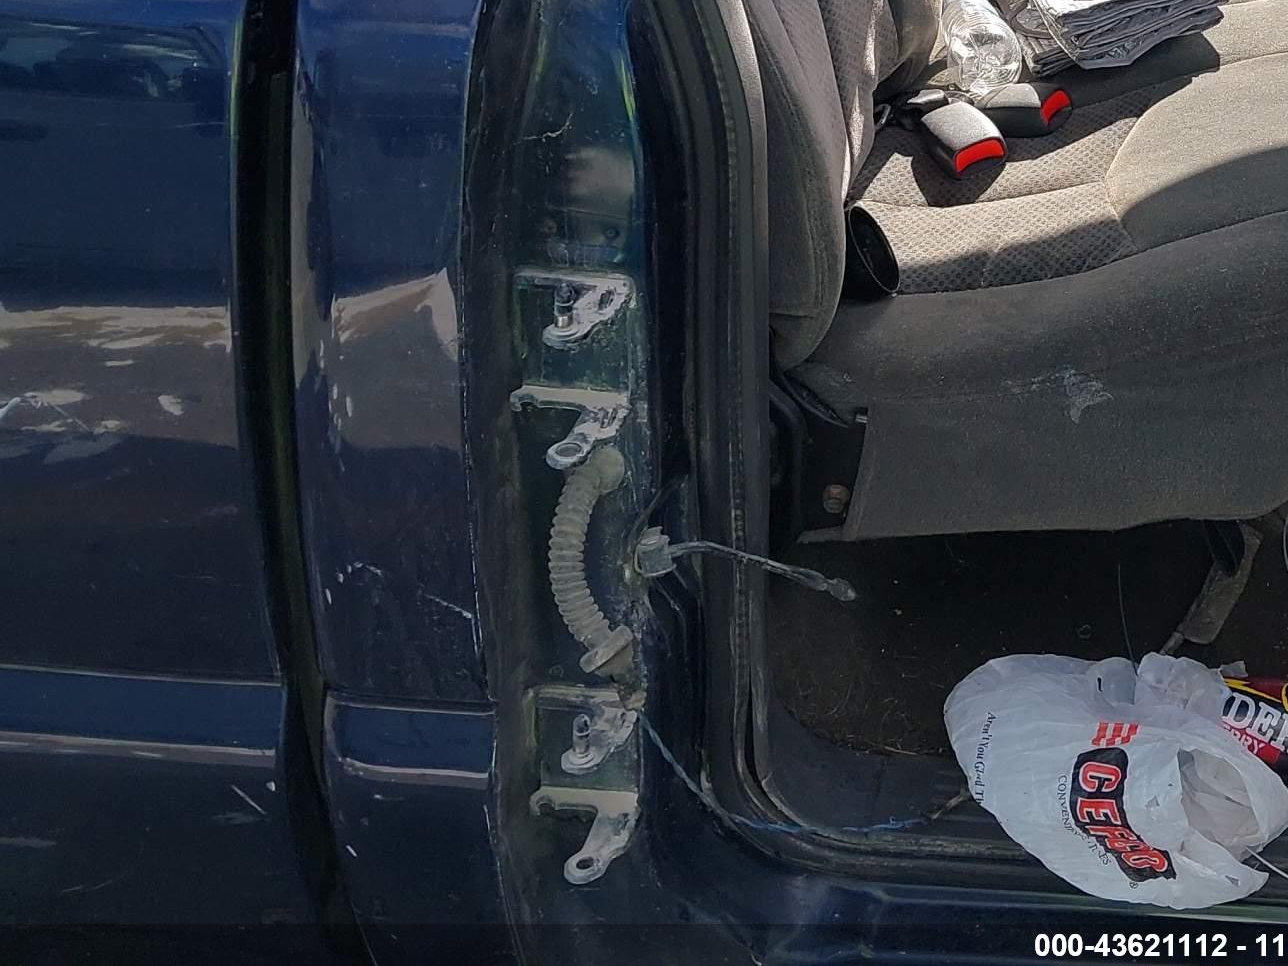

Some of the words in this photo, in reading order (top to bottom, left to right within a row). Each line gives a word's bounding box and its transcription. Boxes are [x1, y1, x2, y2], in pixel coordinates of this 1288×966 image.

[980, 711, 997, 741] Aren't
[975, 741, 989, 760] You
[1075, 760, 1170, 873] CEFCO
